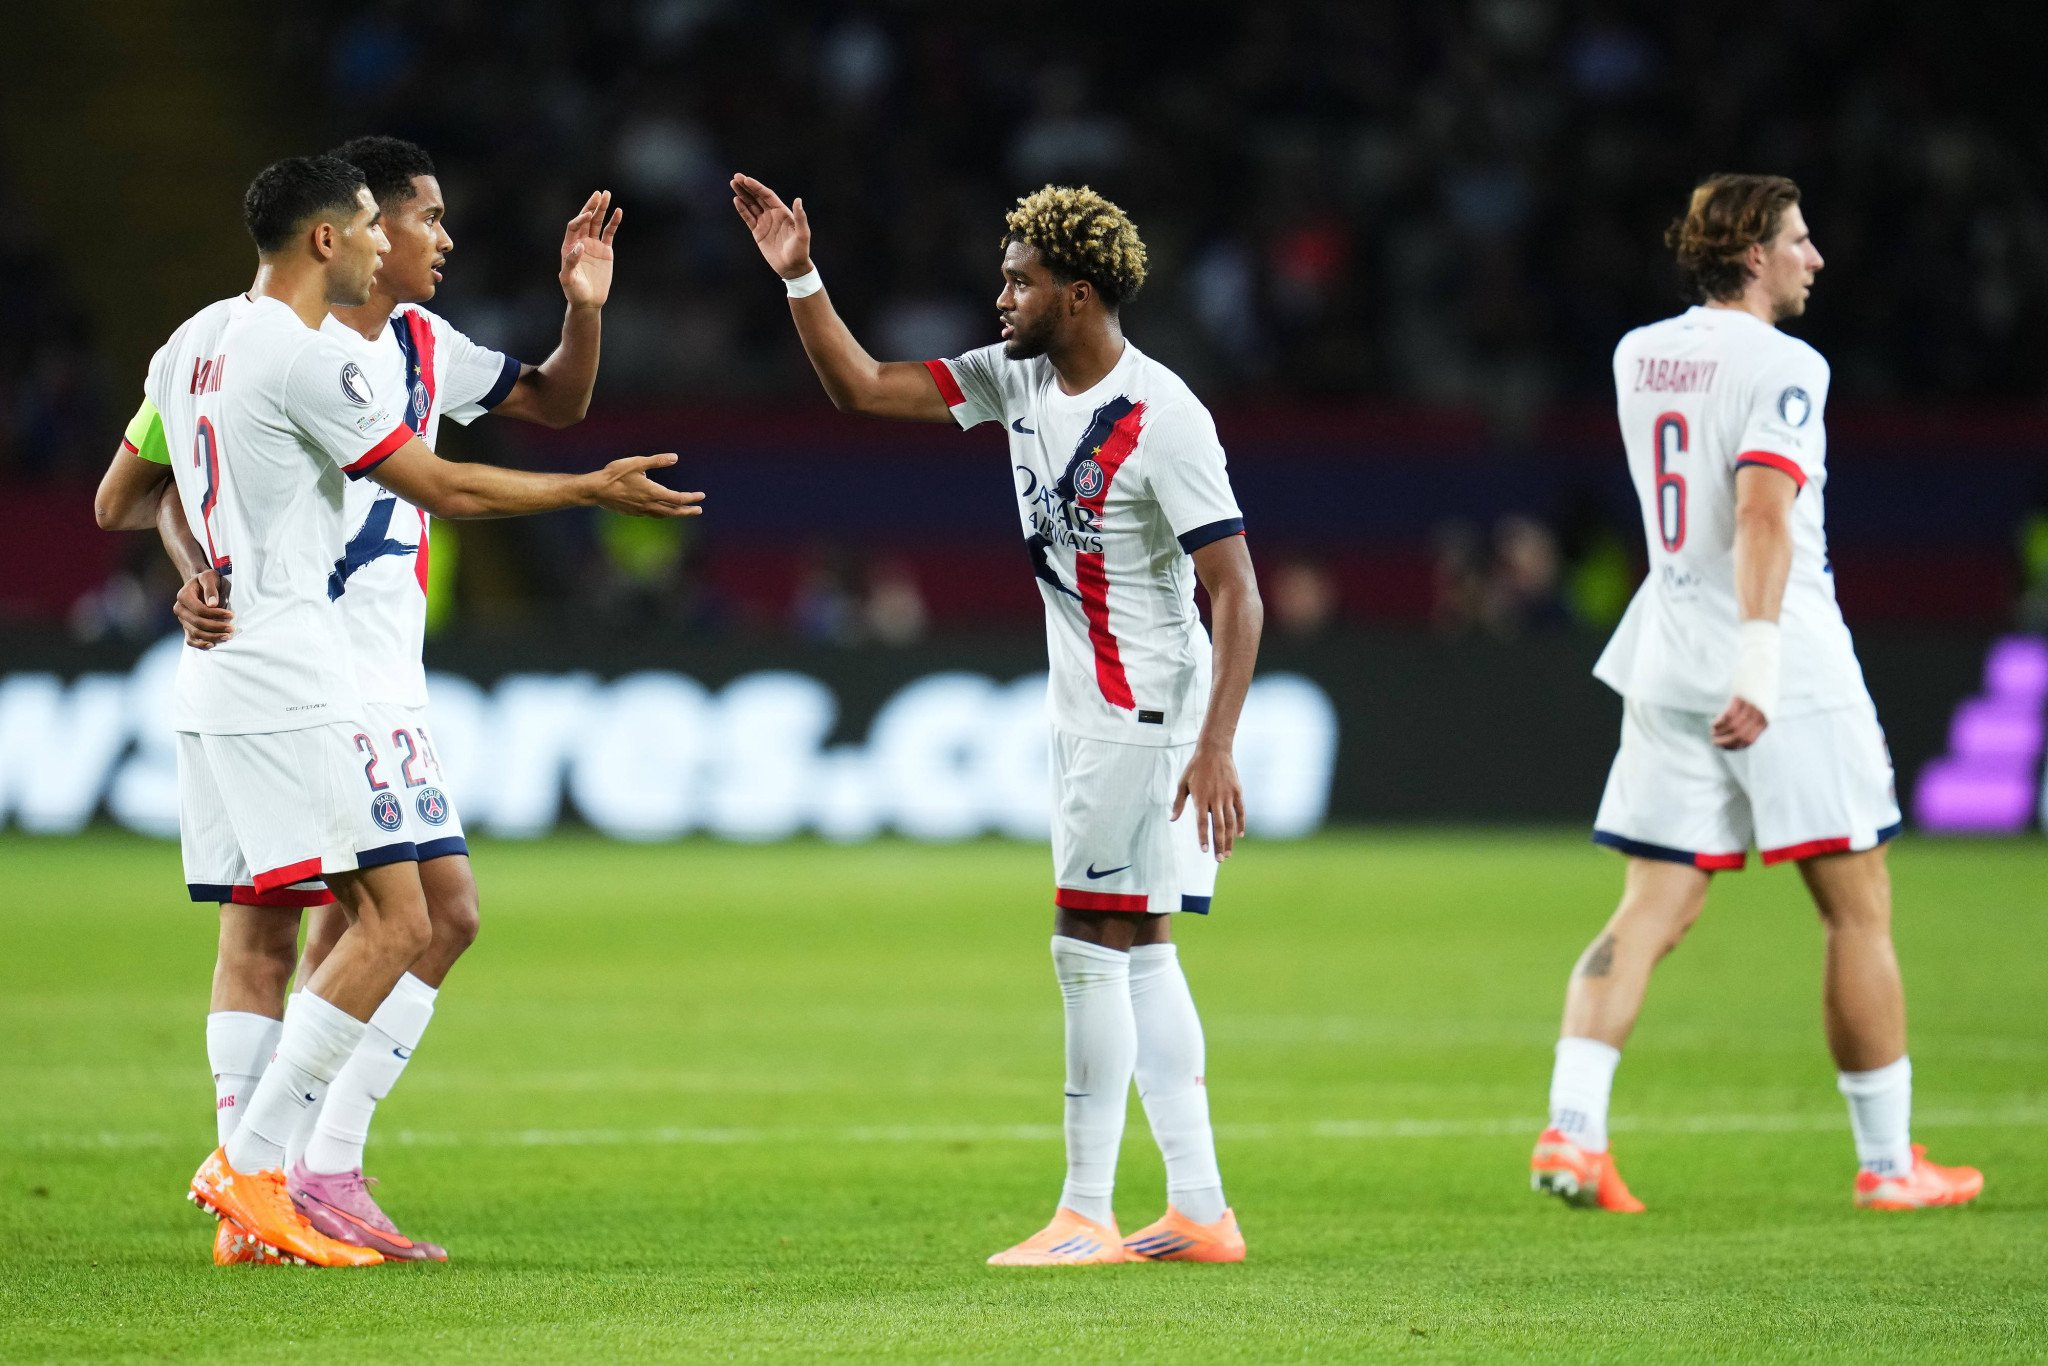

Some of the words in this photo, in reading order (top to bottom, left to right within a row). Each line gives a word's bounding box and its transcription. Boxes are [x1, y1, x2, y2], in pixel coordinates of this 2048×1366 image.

[1082, 461, 1100, 474] PARIS
[1654, 411, 1689, 553] 6
[194, 415, 232, 576] 2
[1028, 511, 1104, 553] AIRWAYS
[352, 732, 390, 793] 2
[375, 794, 397, 807] PARIS
[420, 789, 442, 802] PARIS
